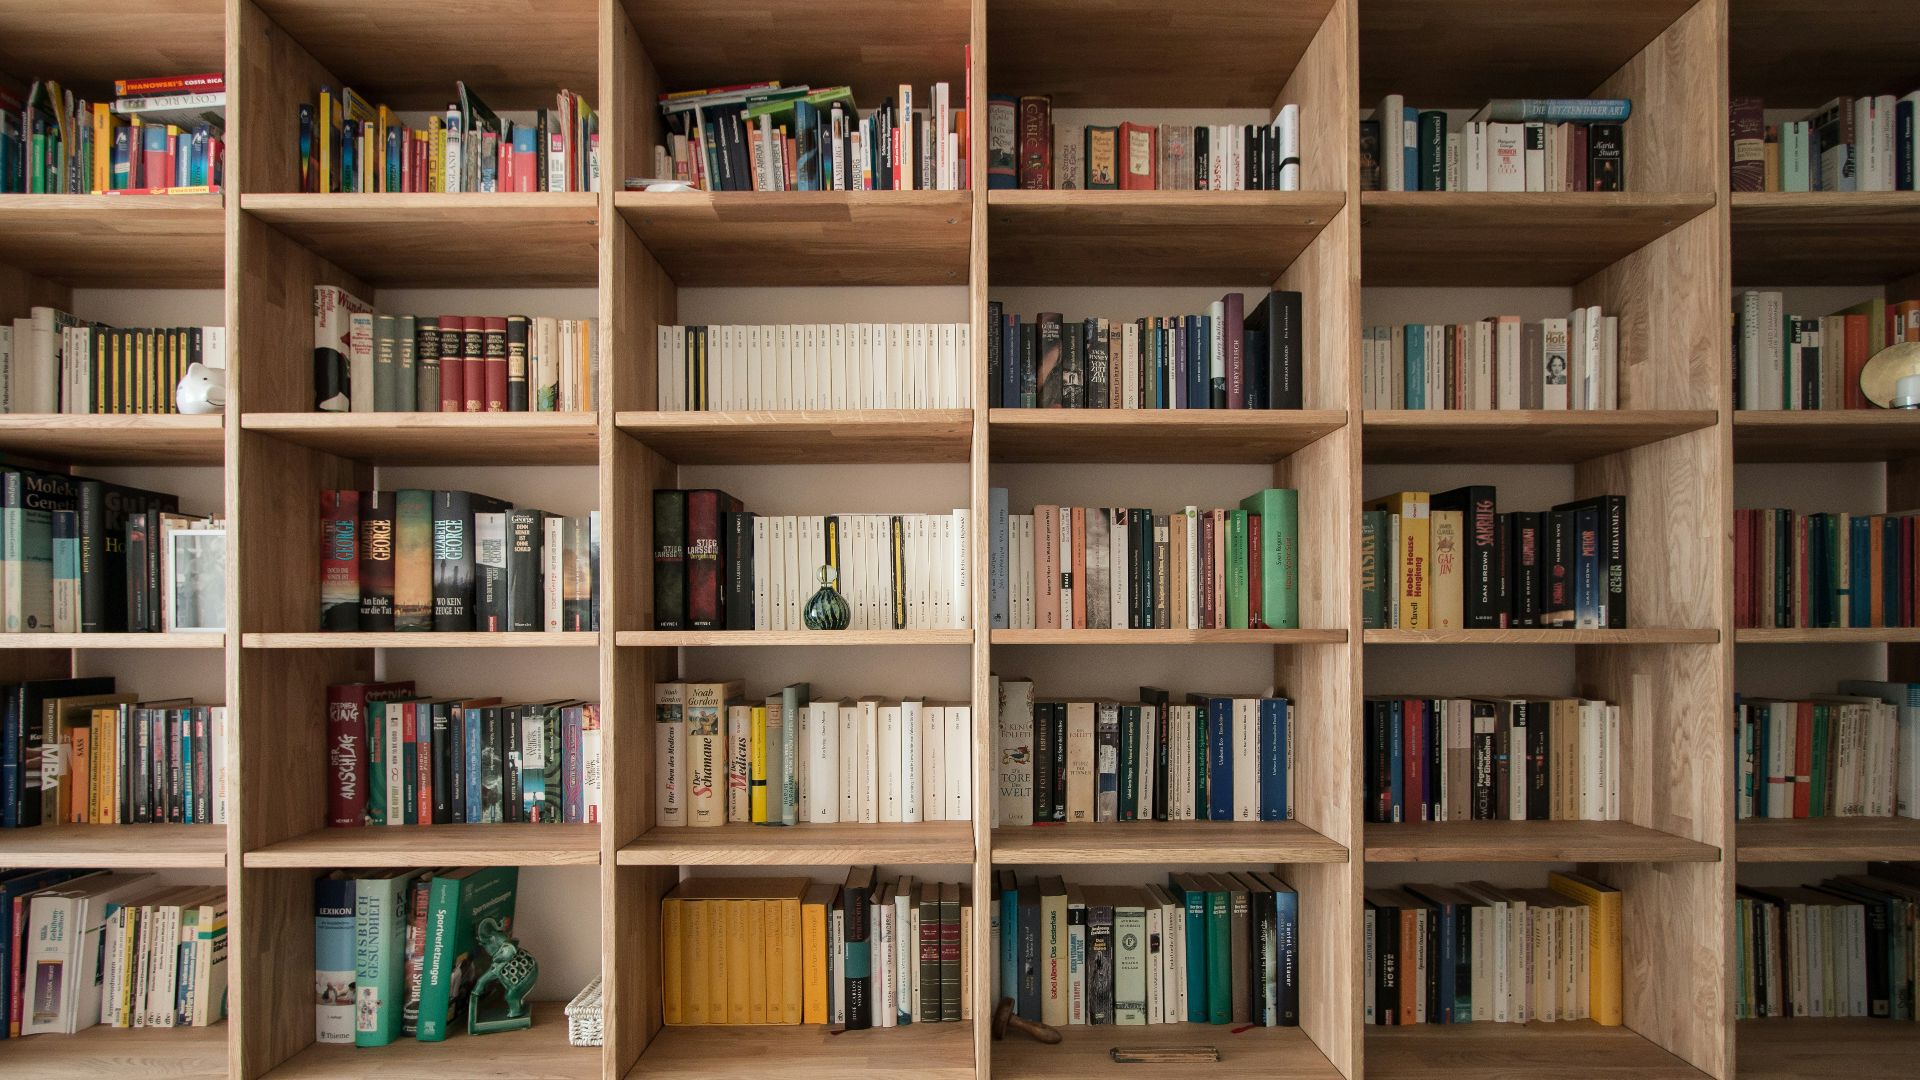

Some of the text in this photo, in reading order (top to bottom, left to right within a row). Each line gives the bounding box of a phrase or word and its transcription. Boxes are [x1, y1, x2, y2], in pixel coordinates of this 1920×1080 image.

[184, 79, 207, 87] COSTA
[207, 77, 224, 85] RICA
[153, 94, 218, 107] COSTA RICA
[1532, 104, 1625, 115] DIE LETZTEN IHRER ART
[1536, 127, 1544, 149] PIPER
[1593, 141, 1615, 149] Maria
[1597, 149, 1621, 158] Stuart
[1546, 333, 1566, 345] Holt
[1475, 500, 1495, 546] SAKRILEG
[435, 519, 446, 560] ELIZABETH
[1610, 504, 1620, 560] ERBARMEN
[335, 519, 354, 562] GEORGE
[373, 519, 391, 562] GEORGE
[446, 519, 463, 561] GEORGE
[696, 539, 718, 549] STIEG
[1582, 530, 1597, 558] METEOR
[688, 546, 719, 556] LARSSON
[1406, 535, 1414, 598] Noble House
[1439, 564, 1452, 576] JIN
[1414, 556, 1423, 598] Hongkong
[372, 597, 389, 606] Ende
[437, 597, 462, 606] WO KEIN
[361, 606, 392, 615] war die Tat
[435, 607, 464, 616] ZEUGE IST
[1410, 602, 1419, 626] Clavell
[692, 688, 715, 697] Noah
[687, 696, 719, 707] Gordon
[331, 709, 360, 724] KING
[1519, 703, 1527, 726] PIPER
[1001, 730, 1032, 738] FOLLETT
[1069, 731, 1093, 739] FOLLETT
[1483, 735, 1491, 774] Eitelkeiten
[41, 743, 60, 792] MBA
[337, 732, 359, 800] ANSCHLAG
[665, 726, 676, 804] Die Erben des Medicus
[692, 737, 713, 799] Schamane
[730, 737, 748, 792] Medicus
[730, 760, 738, 772] Der
[1476, 750, 1485, 788] Fegefeuer
[693, 769, 702, 786] Der
[1001, 773, 1031, 784] TORE
[420, 772, 428, 816] NICK HORNBY
[1000, 787, 1032, 798] WELT
[1039, 793, 1047, 808] KEN
[1479, 787, 1489, 817] WOLFE
[1141, 807, 1149, 818] dtv
[1184, 808, 1192, 817] dtv
[1241, 808, 1250, 818] dtv
[319, 907, 352, 916] LEXIKON
[357, 895, 369, 979] KURSBUCH
[368, 895, 381, 980] GESUNDHEIT
[428, 908, 448, 986] Sportverletzungen
[326, 1031, 351, 1040] Thieme
